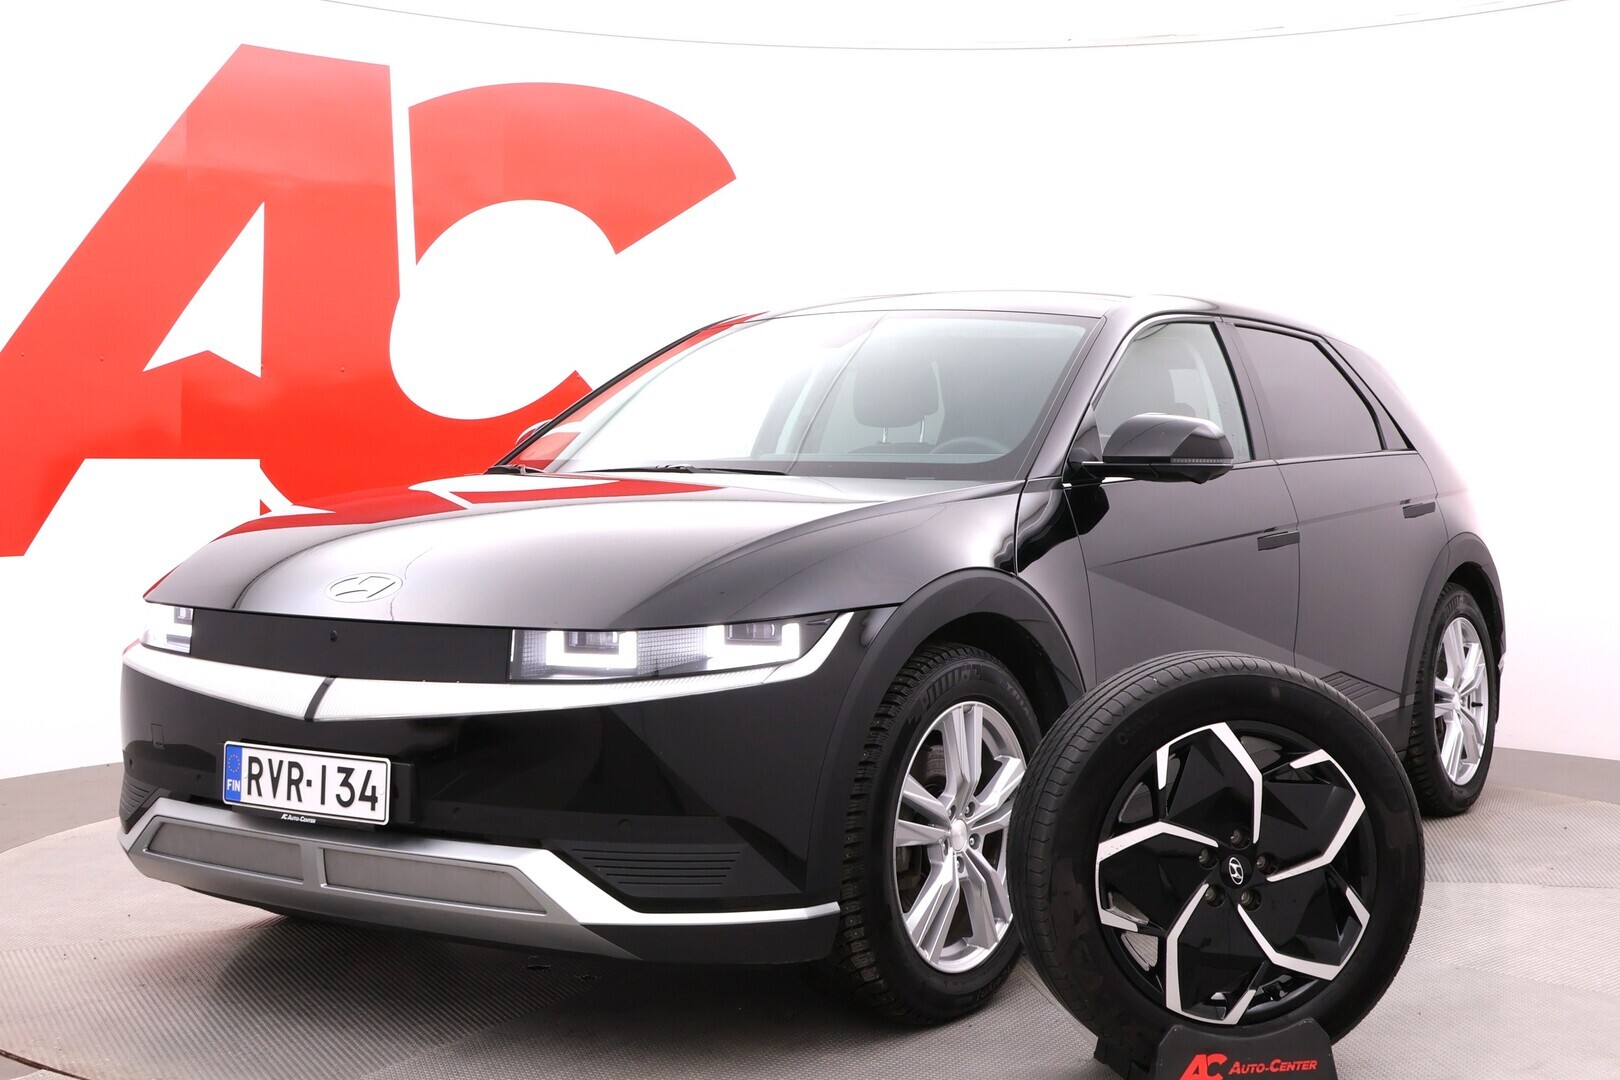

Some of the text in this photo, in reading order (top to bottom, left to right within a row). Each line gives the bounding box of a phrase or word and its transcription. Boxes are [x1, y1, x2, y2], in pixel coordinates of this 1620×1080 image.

[0, 43, 738, 558] AC
[226, 778, 241, 793] FIN
[246, 755, 379, 812] RVR-134
[1179, 1053, 1318, 1080] AC AUTO-CENTER
